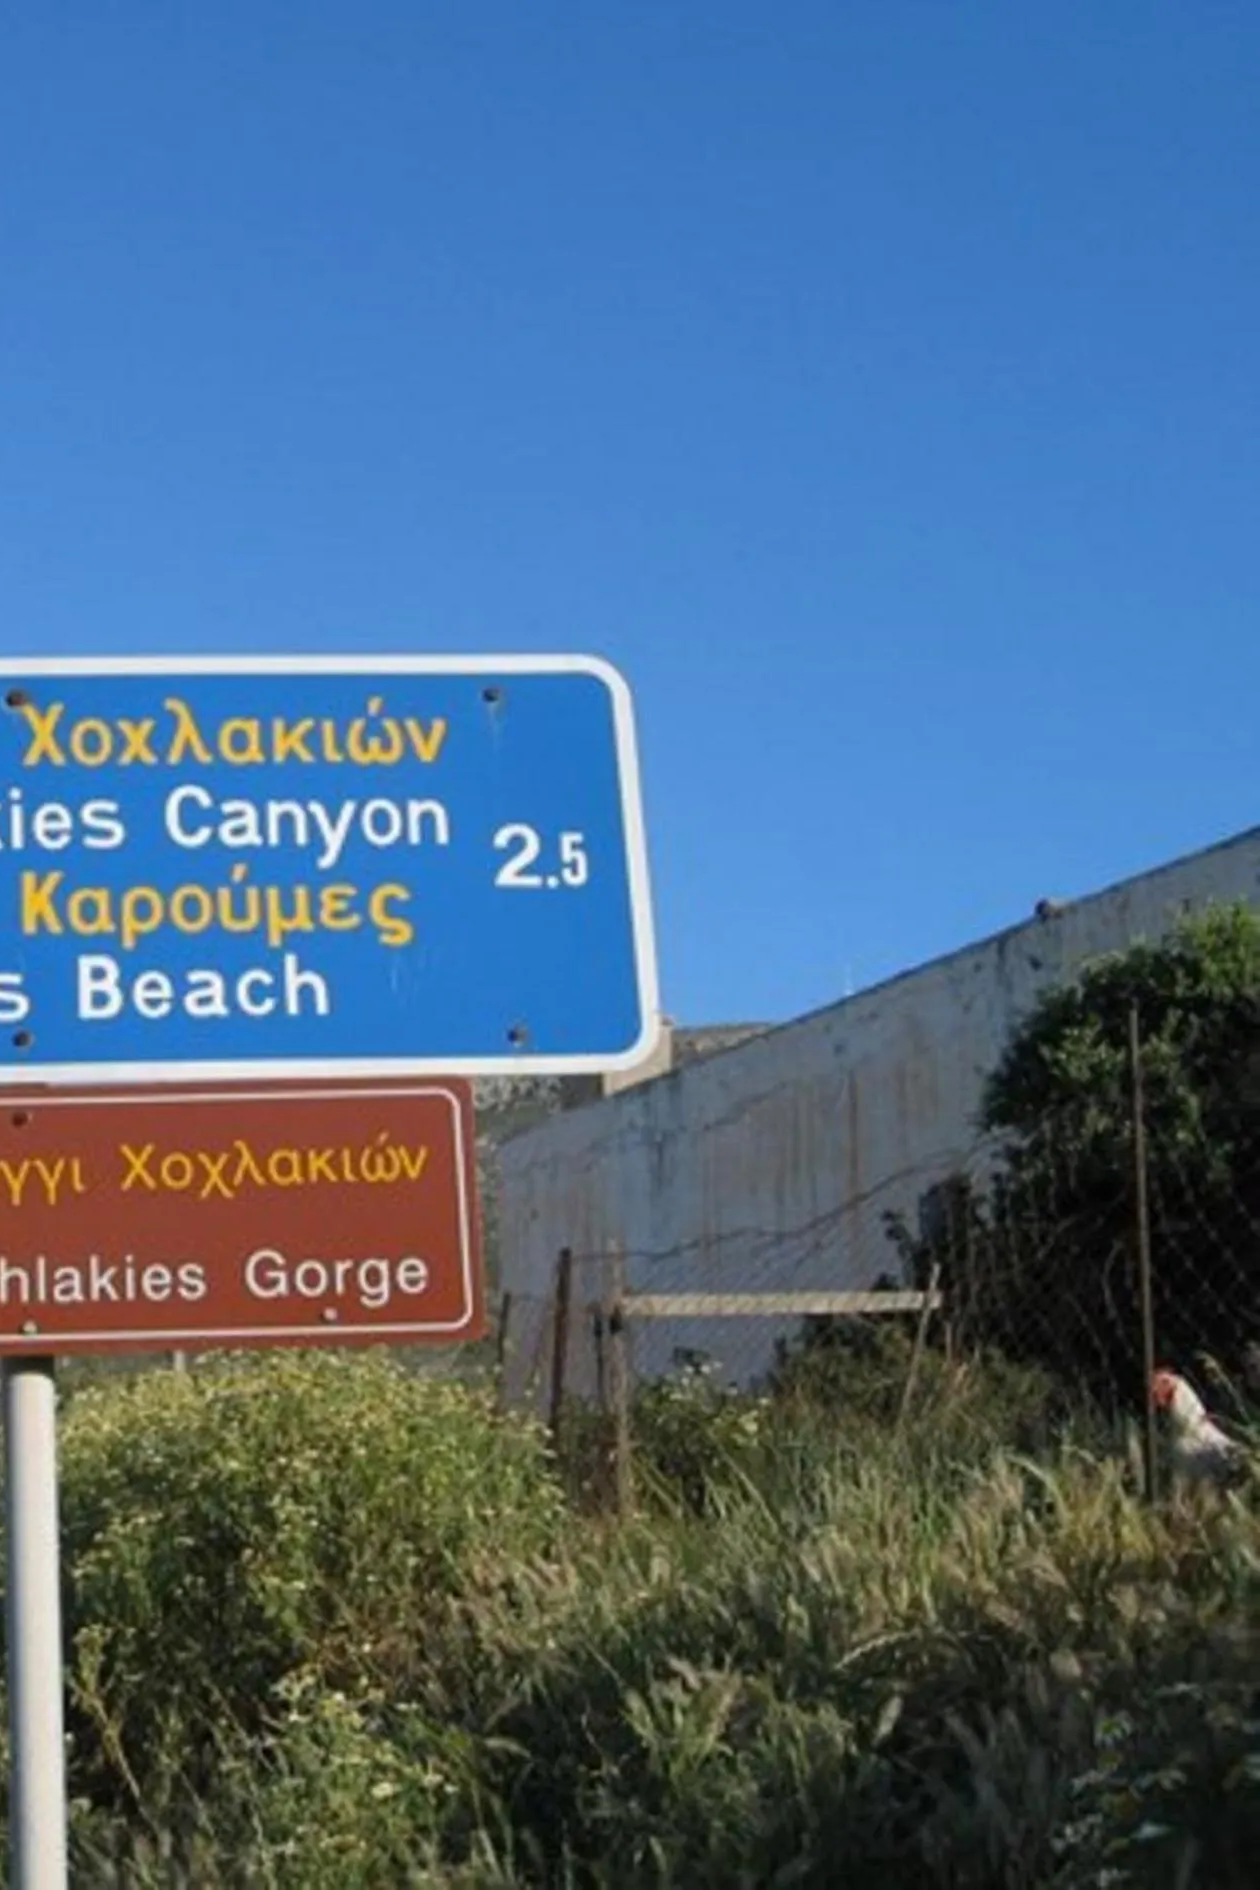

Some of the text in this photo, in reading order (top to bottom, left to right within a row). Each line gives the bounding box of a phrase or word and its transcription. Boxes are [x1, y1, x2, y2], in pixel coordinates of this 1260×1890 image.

[21, 699, 446, 765] Χοχλακιών
[165, 785, 449, 868] Canyon
[493, 824, 587, 888] 2.5
[21, 865, 413, 948] Καρούμες
[78, 954, 329, 1020] Beach
[120, 1133, 428, 1199] Χοχλακιών
[245, 1249, 428, 1307] Gorge
